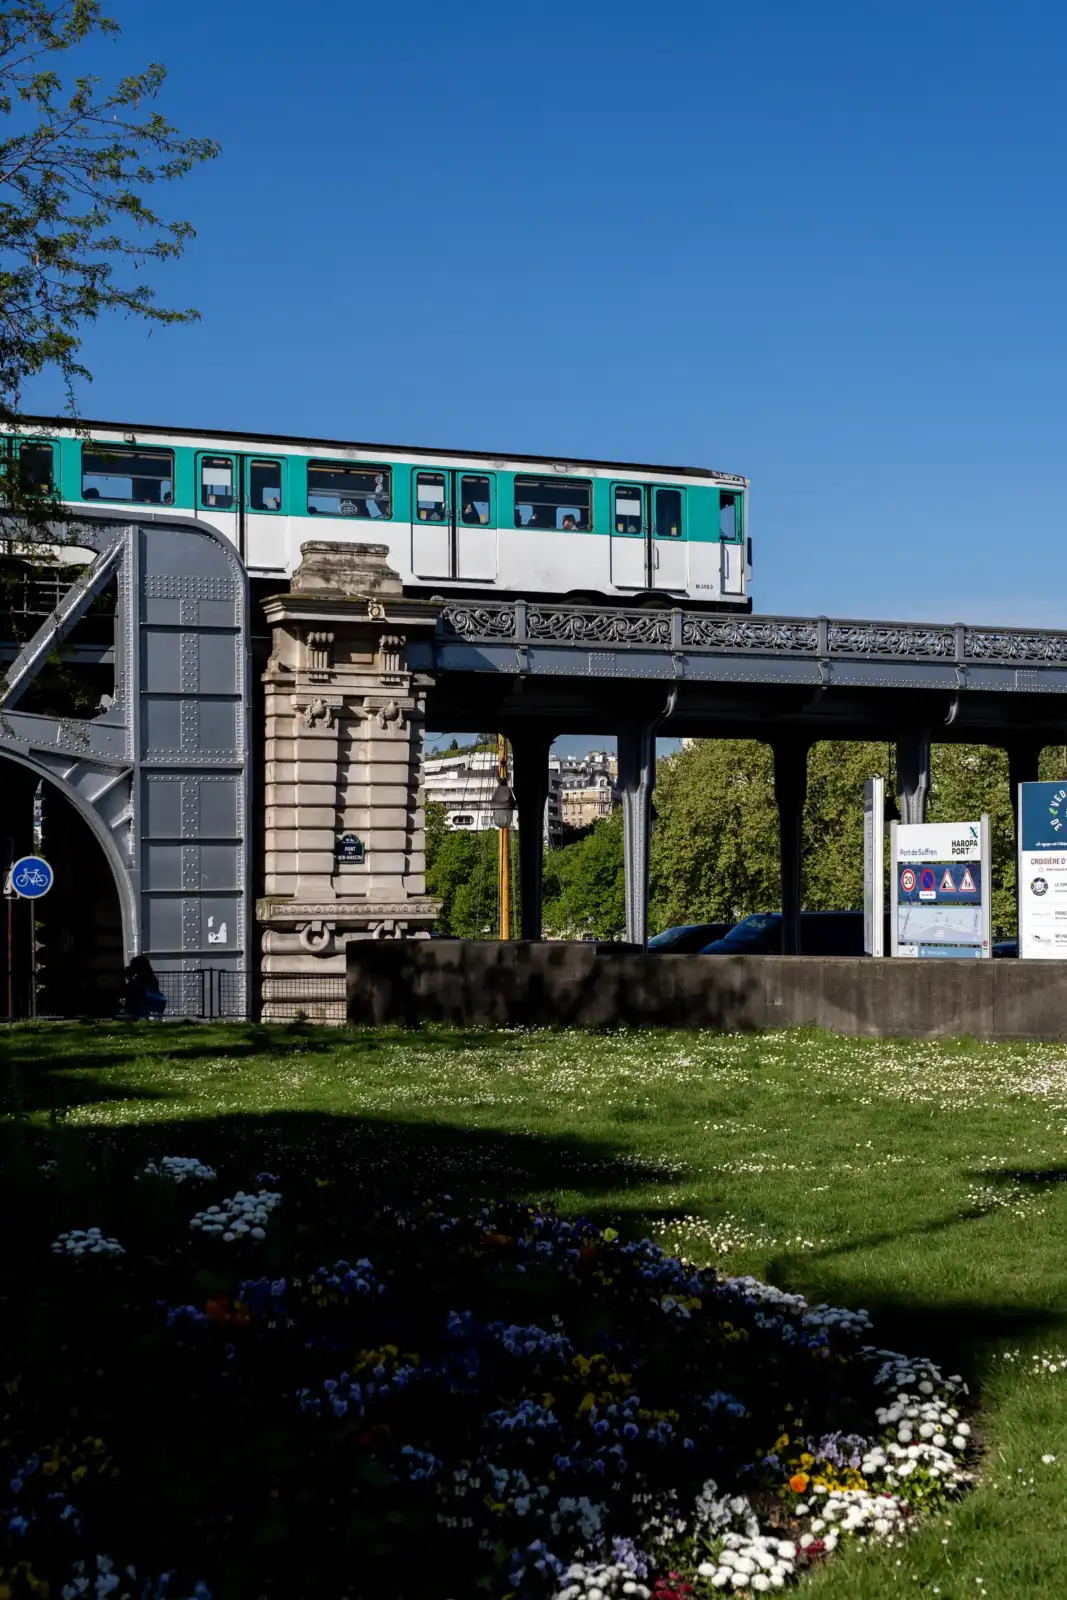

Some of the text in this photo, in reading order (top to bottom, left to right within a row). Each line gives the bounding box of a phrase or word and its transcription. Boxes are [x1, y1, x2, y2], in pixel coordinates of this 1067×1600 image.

[1050, 788, 1067, 807] VED
[1050, 818, 1063, 832] DE
[918, 848, 938, 856] Suffren
[1030, 856, 1060, 865] CROISIÈRE
[904, 876, 913, 885] 20
